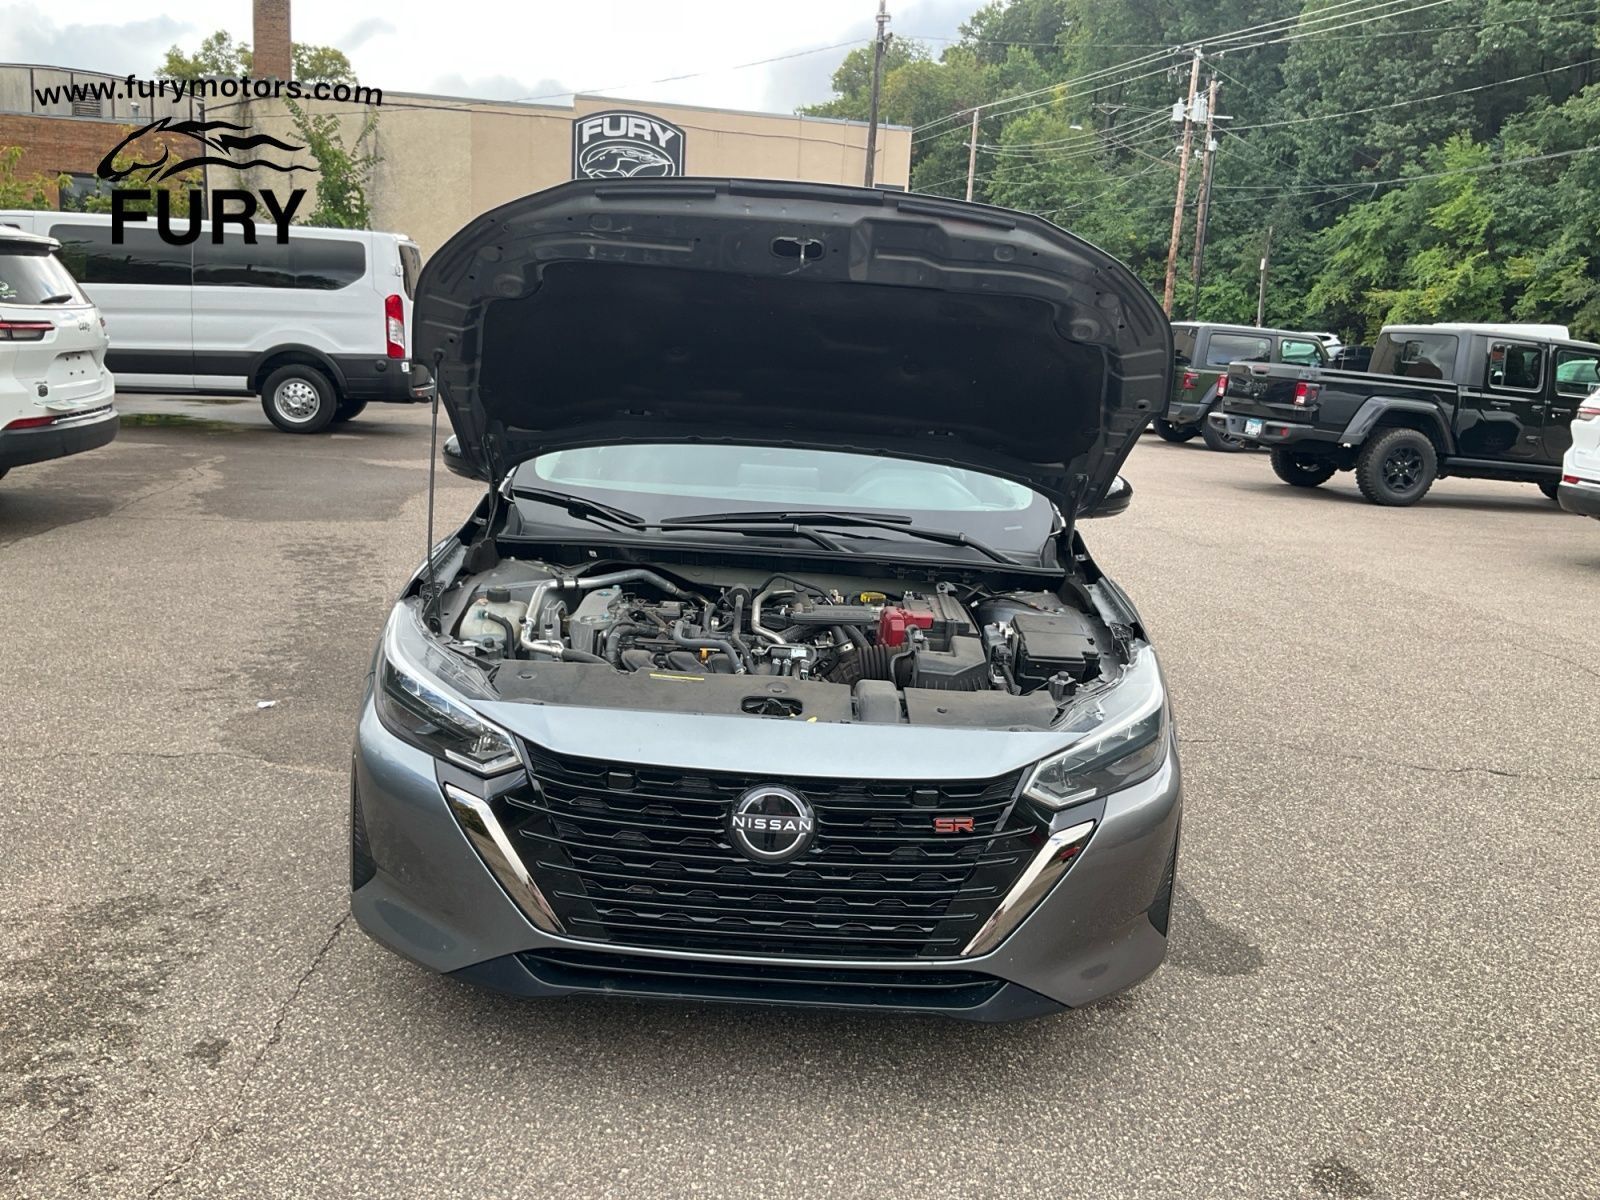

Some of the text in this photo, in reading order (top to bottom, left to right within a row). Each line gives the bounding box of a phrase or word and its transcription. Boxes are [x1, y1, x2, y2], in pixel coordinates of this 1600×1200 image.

[582, 116, 675, 148] FURY
[732, 815, 812, 832] NISSAN
[934, 816, 975, 833] SR
